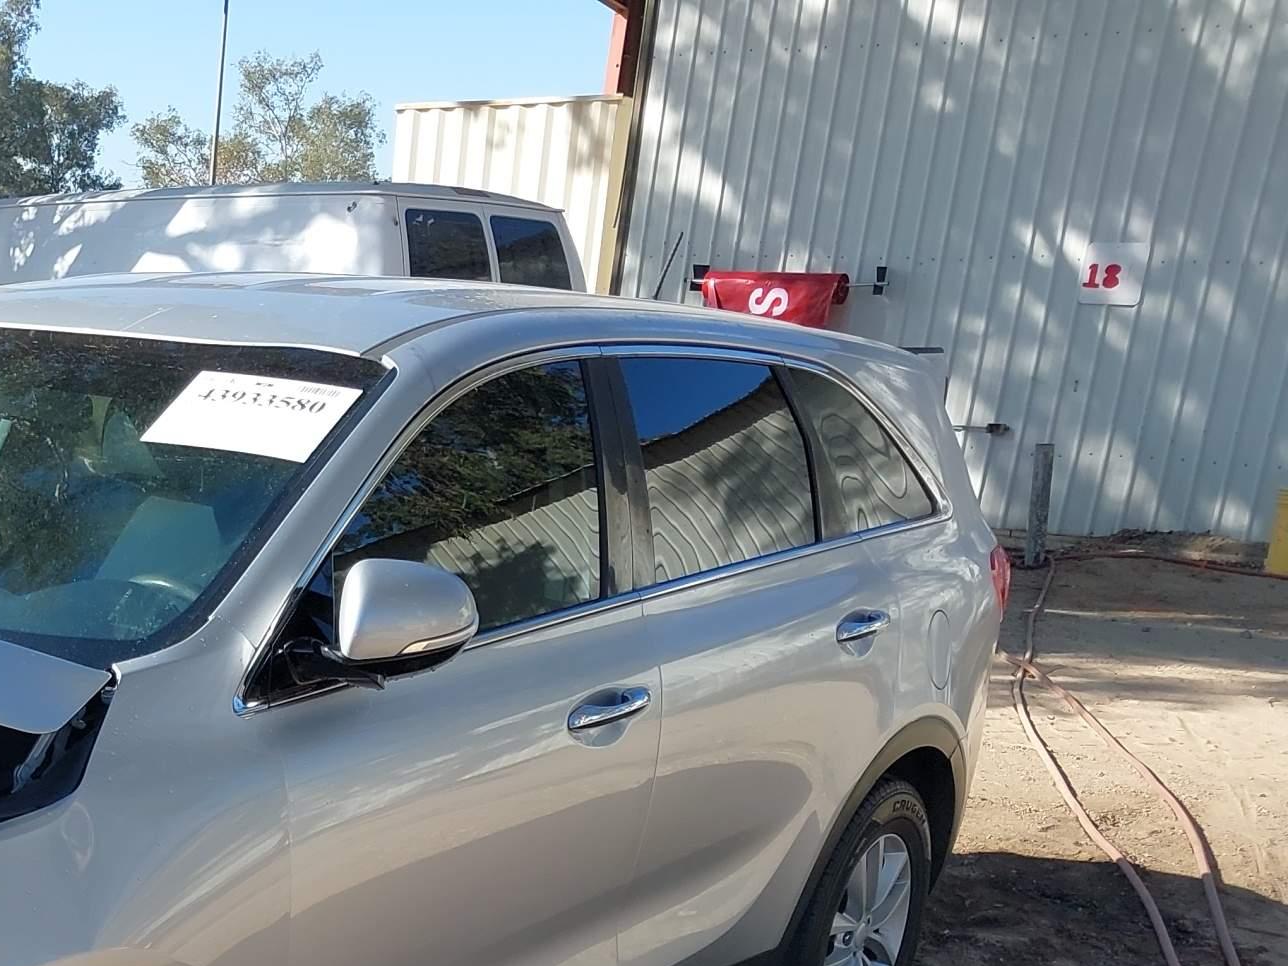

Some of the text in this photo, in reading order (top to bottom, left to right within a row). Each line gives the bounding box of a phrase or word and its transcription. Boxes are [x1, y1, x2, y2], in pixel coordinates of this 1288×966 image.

[1082, 263, 1122, 289] 18
[748, 287, 789, 317] S
[197, 388, 327, 414] 43933580
